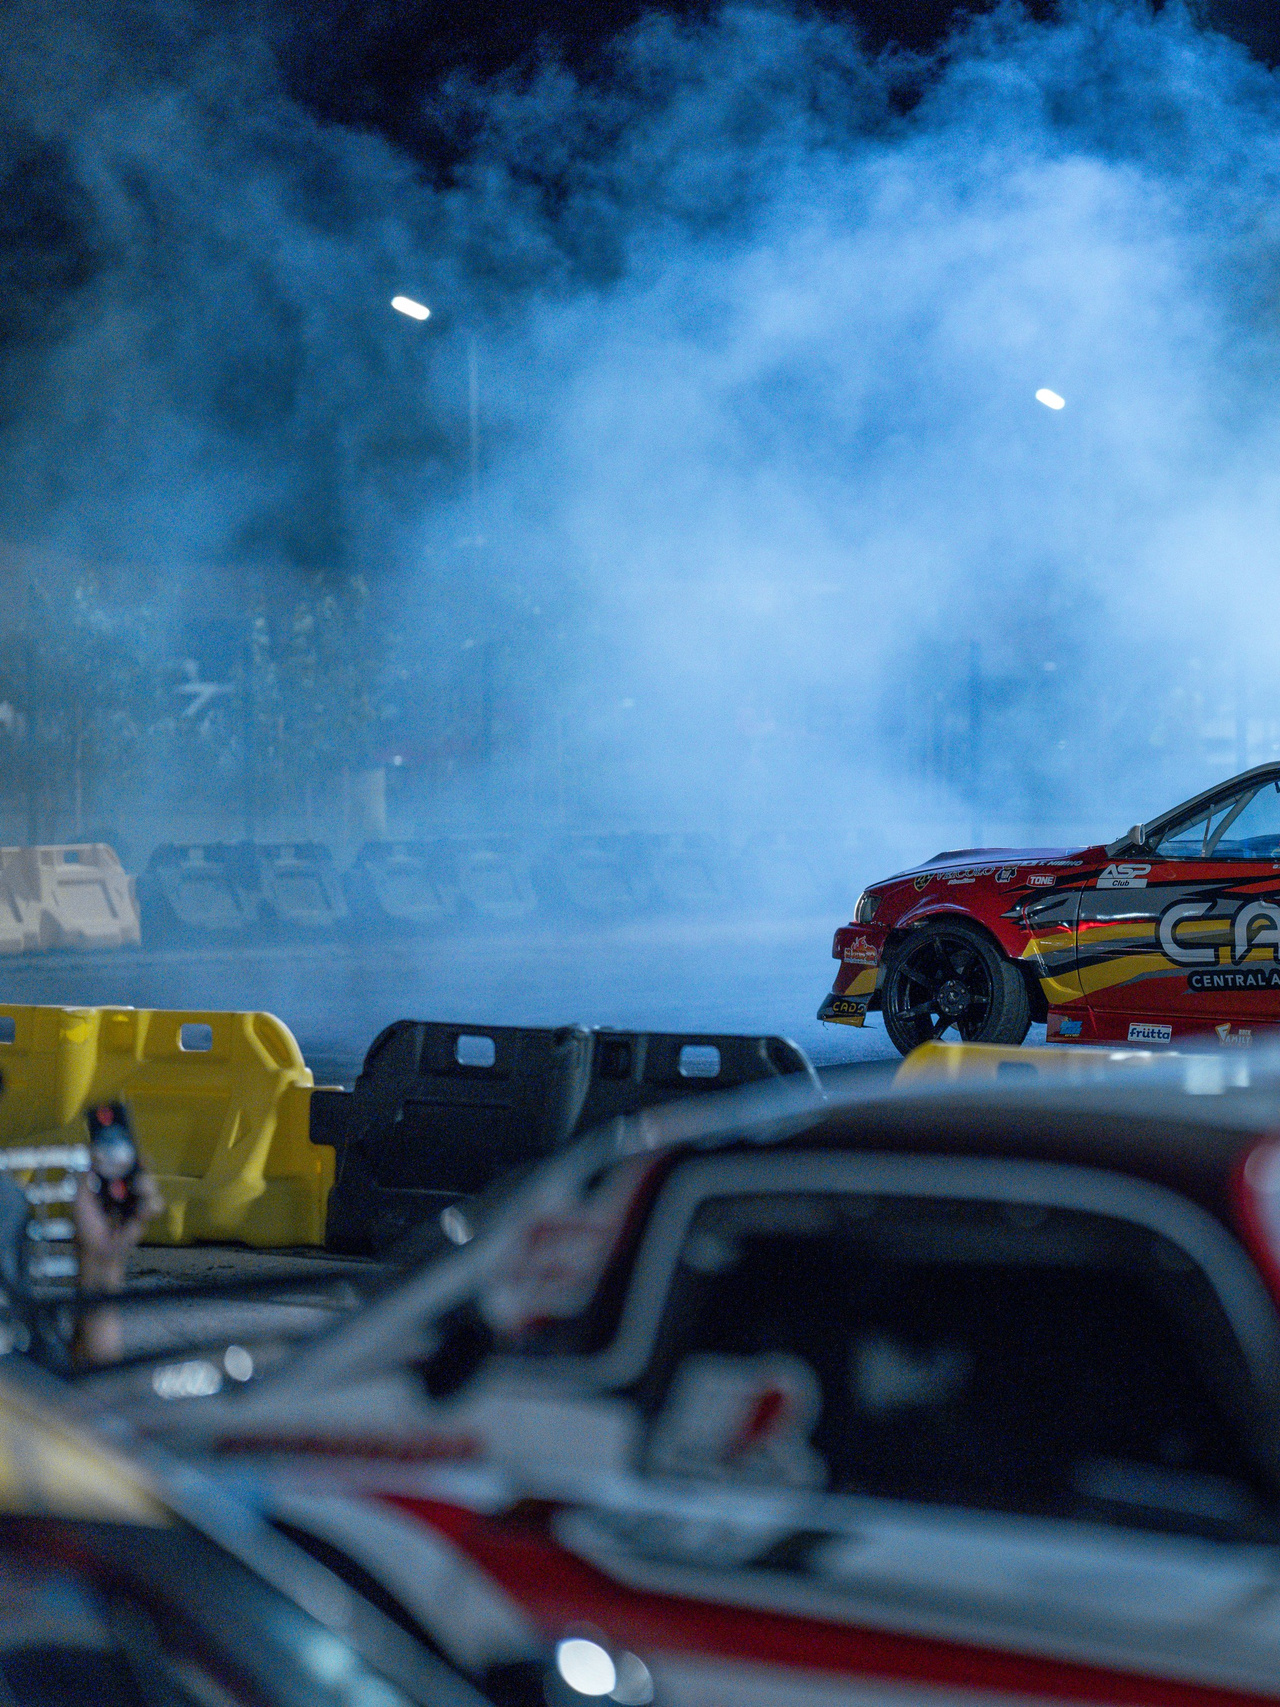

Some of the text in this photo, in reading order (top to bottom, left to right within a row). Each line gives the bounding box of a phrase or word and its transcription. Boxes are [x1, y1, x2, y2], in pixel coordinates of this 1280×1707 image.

[1099, 863, 1152, 879] ASP
[1030, 876, 1053, 885] TONE
[1192, 972, 1266, 988] CENTRAL
[833, 1002, 867, 1012] CADS
[1129, 1028, 1170, 1040] frütta
